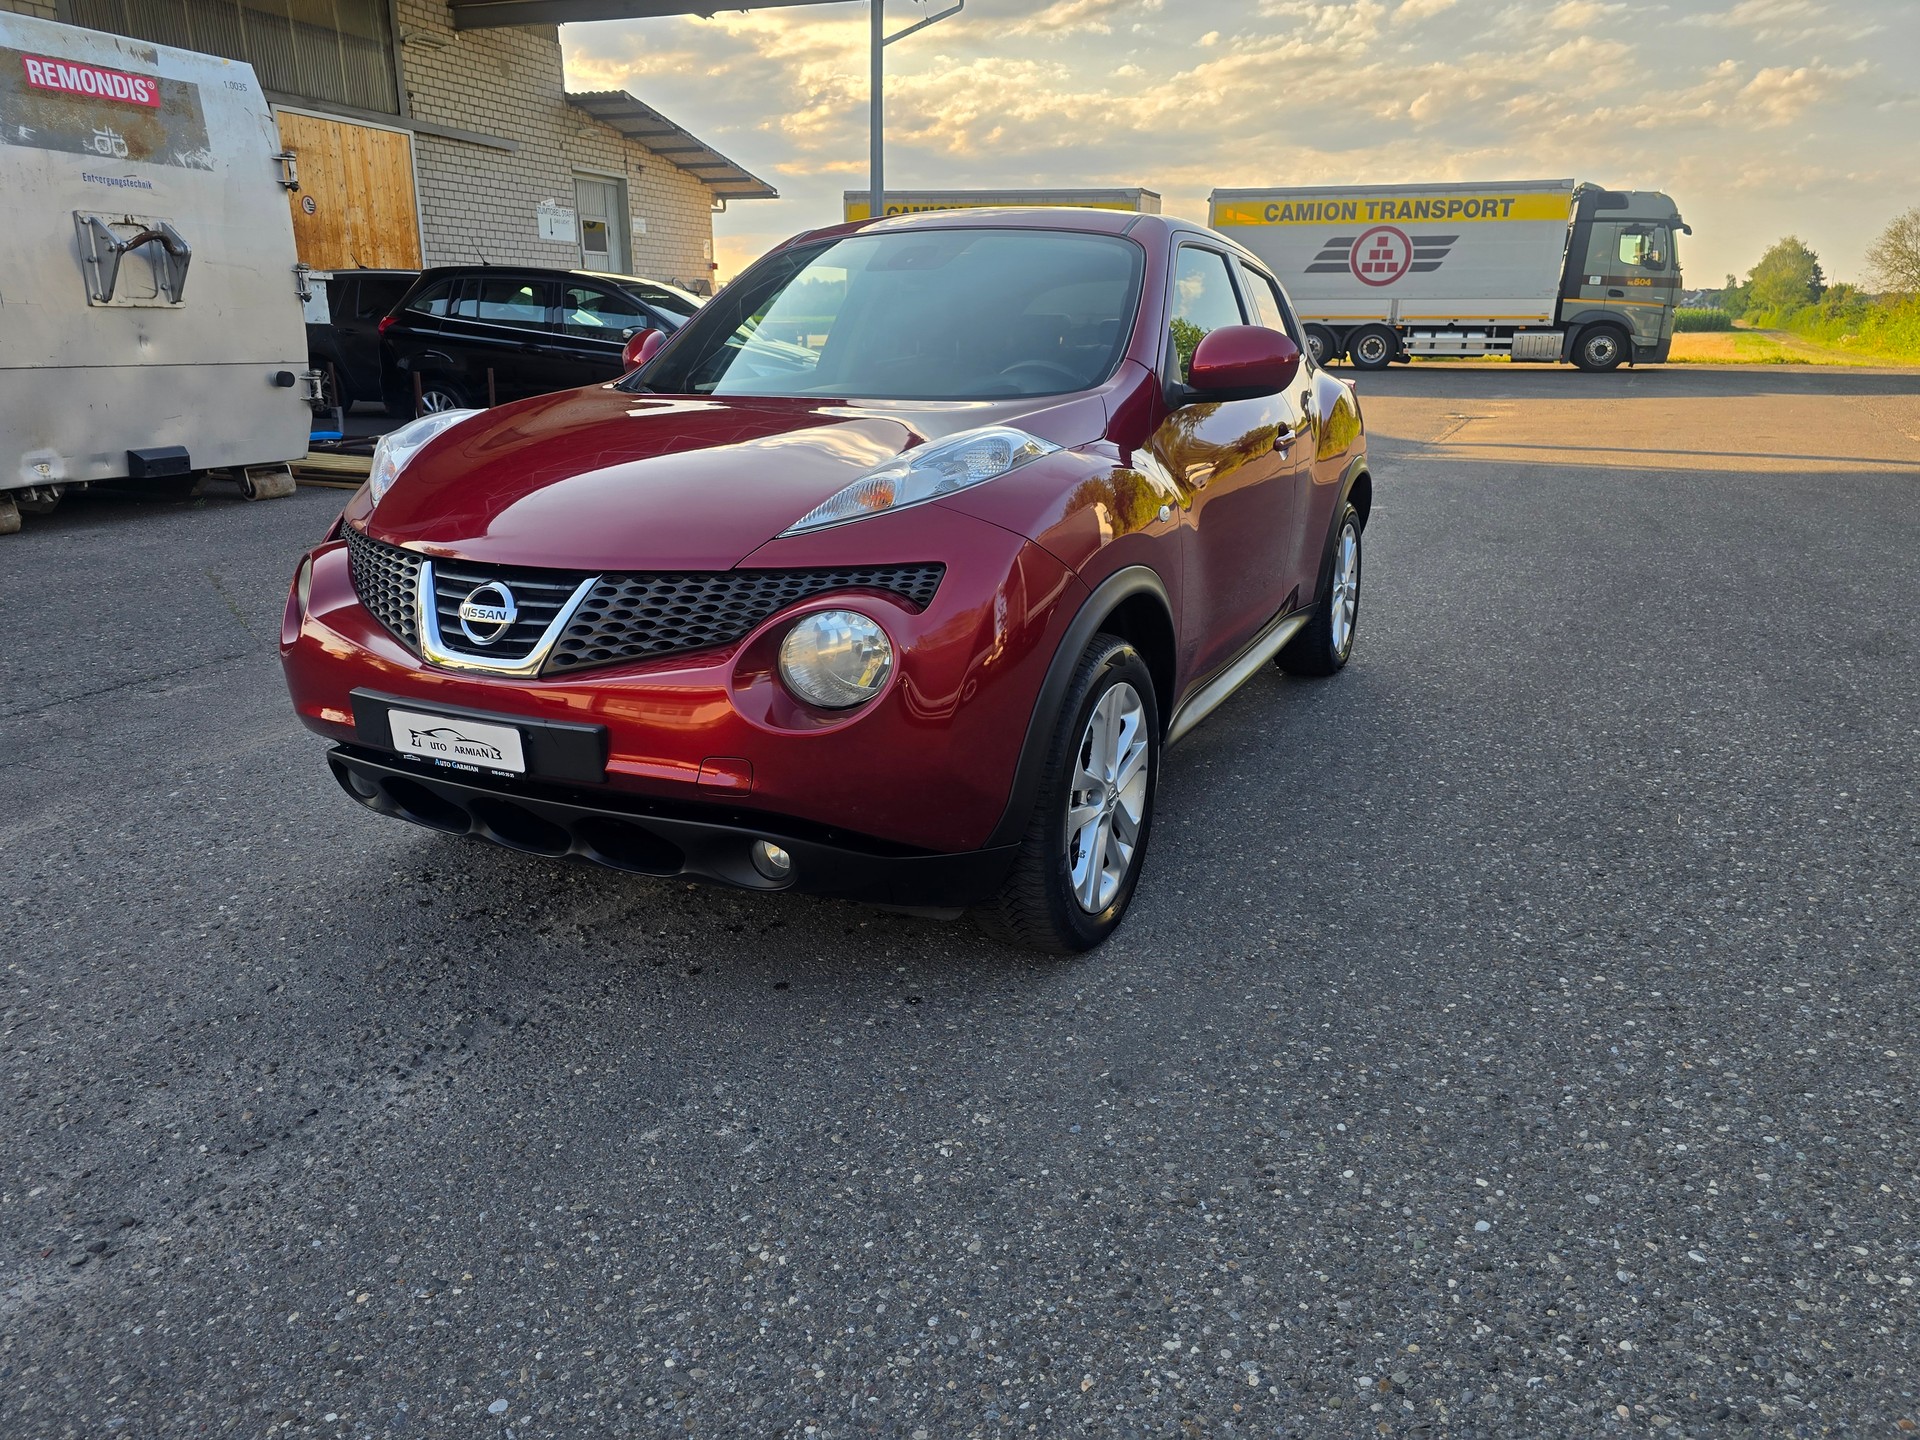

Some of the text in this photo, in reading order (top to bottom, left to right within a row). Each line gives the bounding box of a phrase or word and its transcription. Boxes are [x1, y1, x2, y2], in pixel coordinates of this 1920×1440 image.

[1263, 198, 1516, 222] CAMION TRANSPORT
[462, 606, 507, 620] NISSAN
